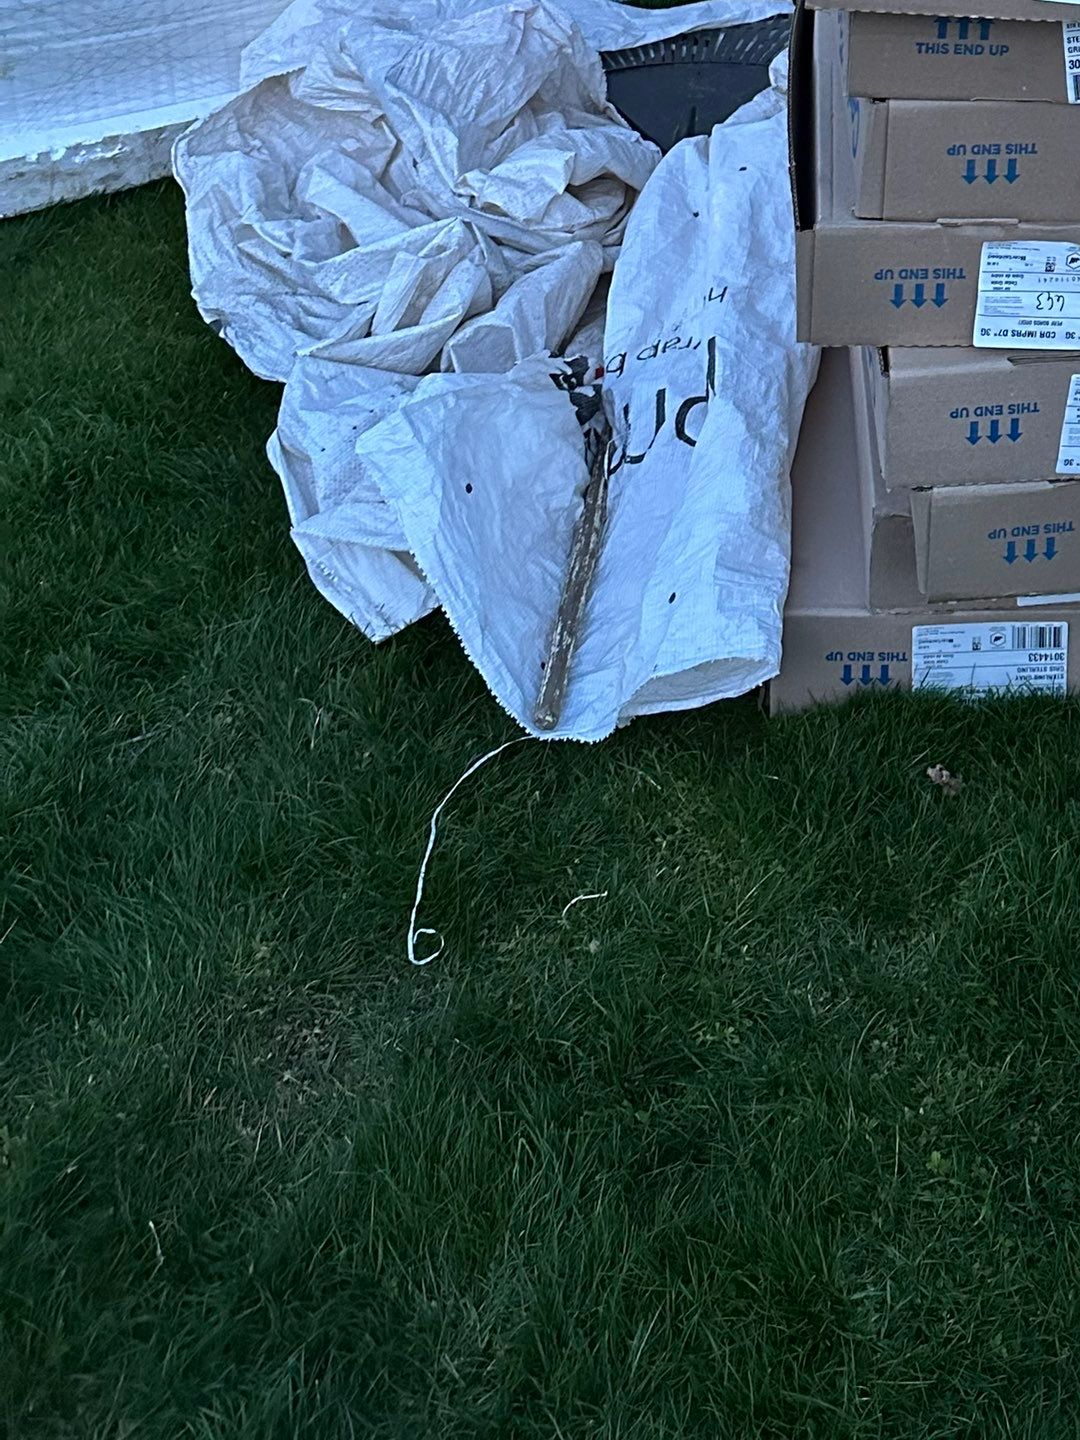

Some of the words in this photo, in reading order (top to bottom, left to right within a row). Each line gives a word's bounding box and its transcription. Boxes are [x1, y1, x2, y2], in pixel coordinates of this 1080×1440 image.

[915, 42, 949, 54] THIS
[953, 43, 984, 55] END
[989, 44, 1009, 56] UP
[946, 144, 966, 155] UP
[970, 143, 1001, 155] END
[1005, 142, 1037, 154] THIS
[874, 268, 893, 280] UP
[898, 268, 928, 280] END
[934, 267, 965, 279] THIS
[1010, 329, 1036, 338] IMPRS
[1039, 330, 1055, 338] CDR
[949, 406, 969, 418] UP
[973, 404, 1003, 416] END
[1007, 401, 1039, 414] THIS
[987, 527, 1006, 539] UP
[1010, 523, 1040, 537] END
[1043, 520, 1074, 534] THIS
[825, 651, 842, 662] UP
[847, 651, 874, 662] END
[877, 651, 906, 662] THIS
[1028, 652, 1064, 661] 3014433
